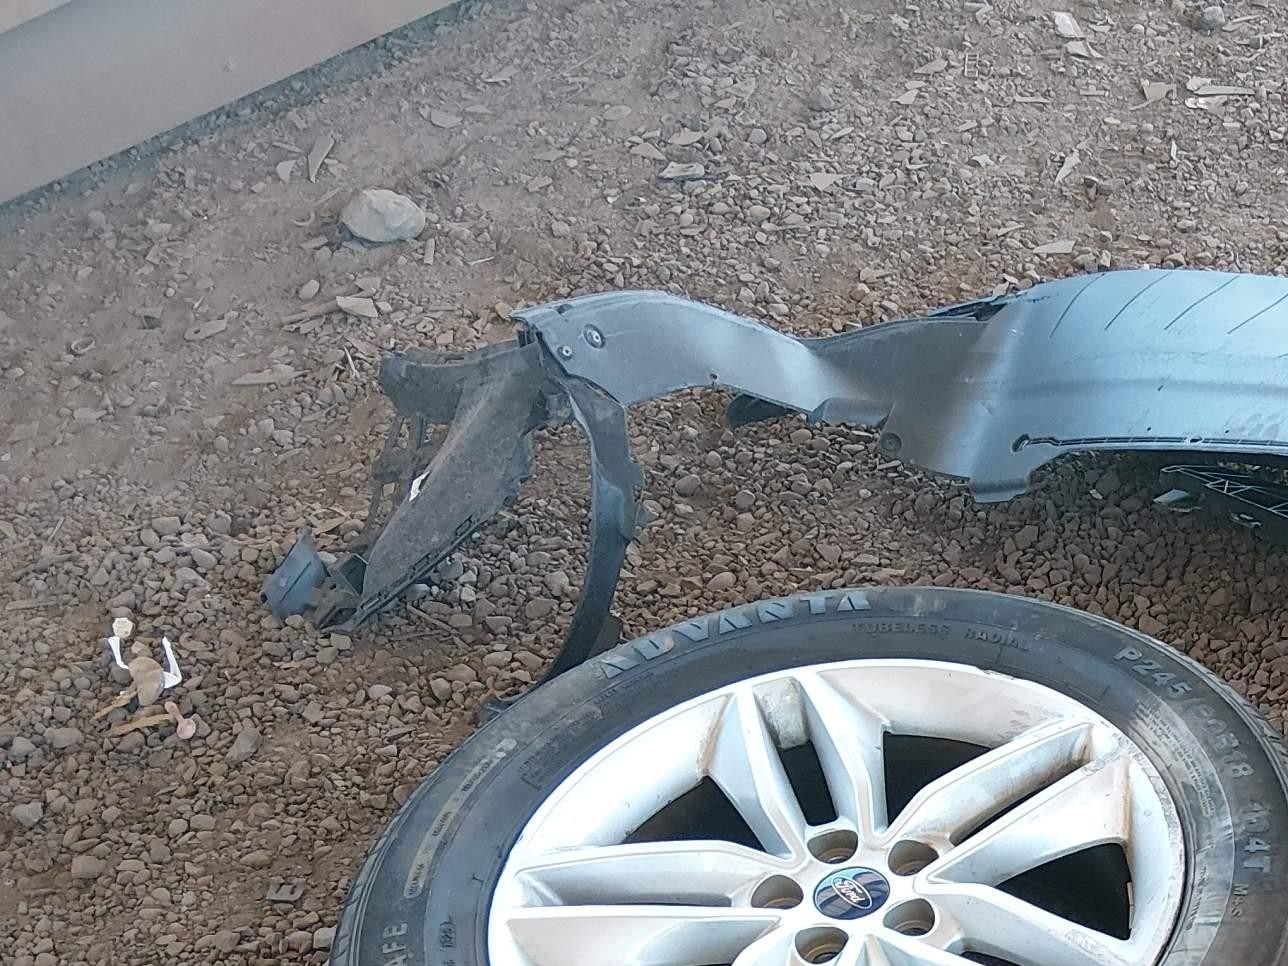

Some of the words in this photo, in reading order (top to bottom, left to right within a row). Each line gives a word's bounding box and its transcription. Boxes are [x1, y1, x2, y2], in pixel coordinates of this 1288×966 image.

[600, 590, 871, 680] ADVANTA
[852, 622, 950, 636] TUBELESS
[834, 879, 868, 905] Ford
